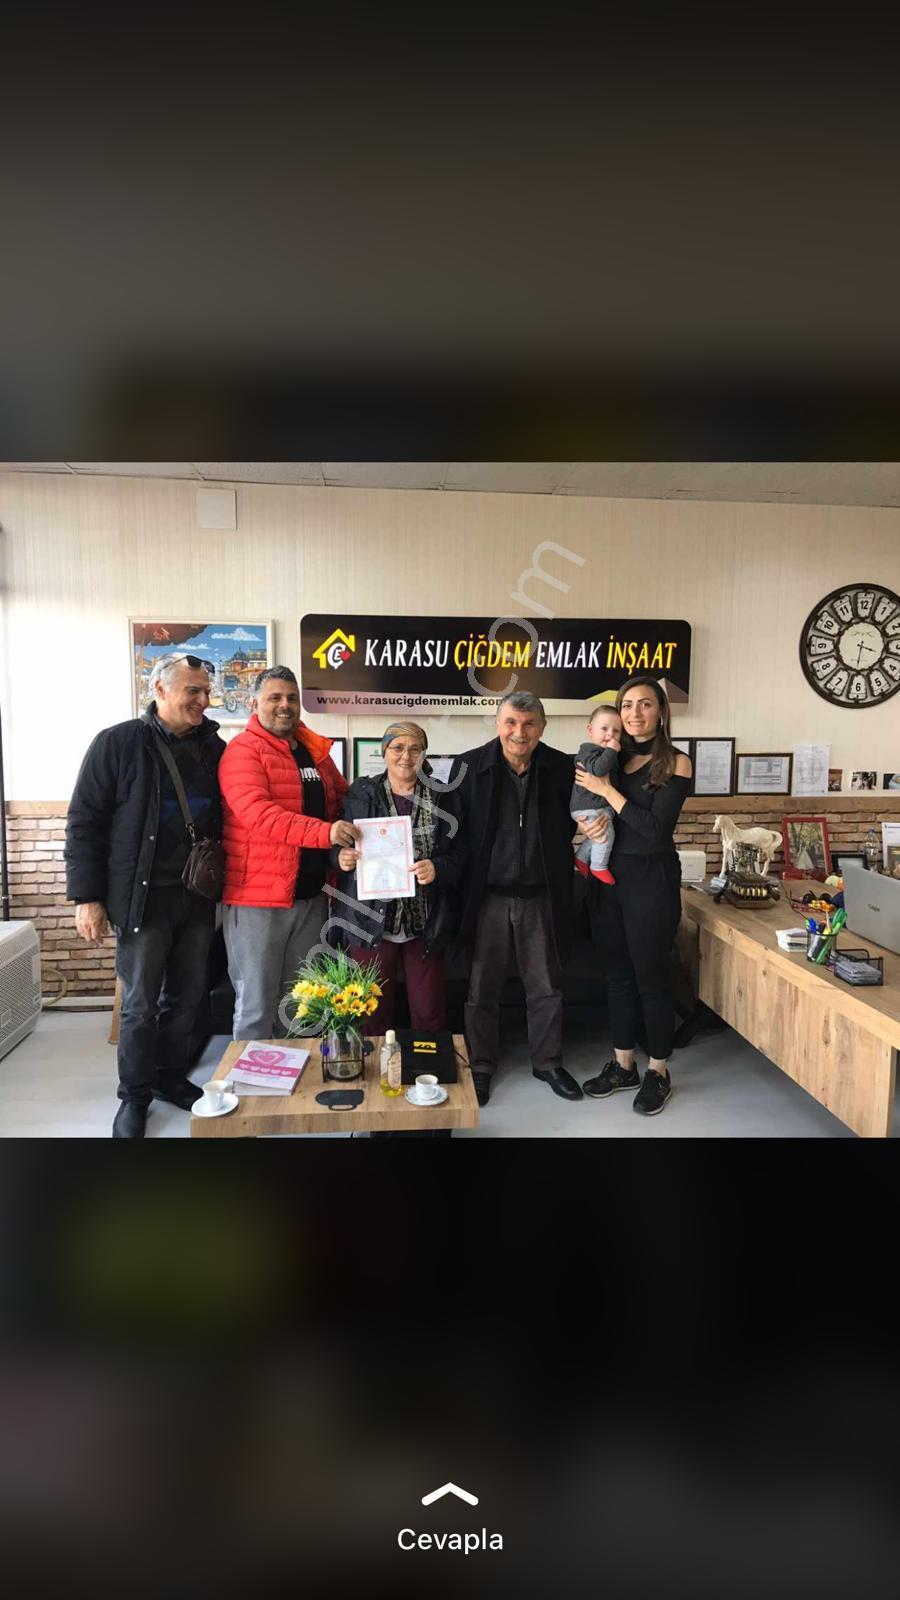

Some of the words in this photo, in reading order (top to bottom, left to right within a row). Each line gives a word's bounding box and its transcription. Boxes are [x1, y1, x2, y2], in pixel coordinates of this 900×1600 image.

[860, 600, 869, 610] 12
[840, 605, 849, 616] 11
[881, 606, 887, 615] 1
[824, 620, 834, 630] 10
[364, 639, 450, 667] KARASU
[454, 633, 531, 670] ÇİĞDEM
[535, 641, 602, 668] EMLAK
[606, 635, 677, 675] İNŞAAT
[822, 662, 831, 670] 8
[835, 677, 843, 686] 7
[875, 677, 882, 687] 5
[855, 682, 861, 692] 6
